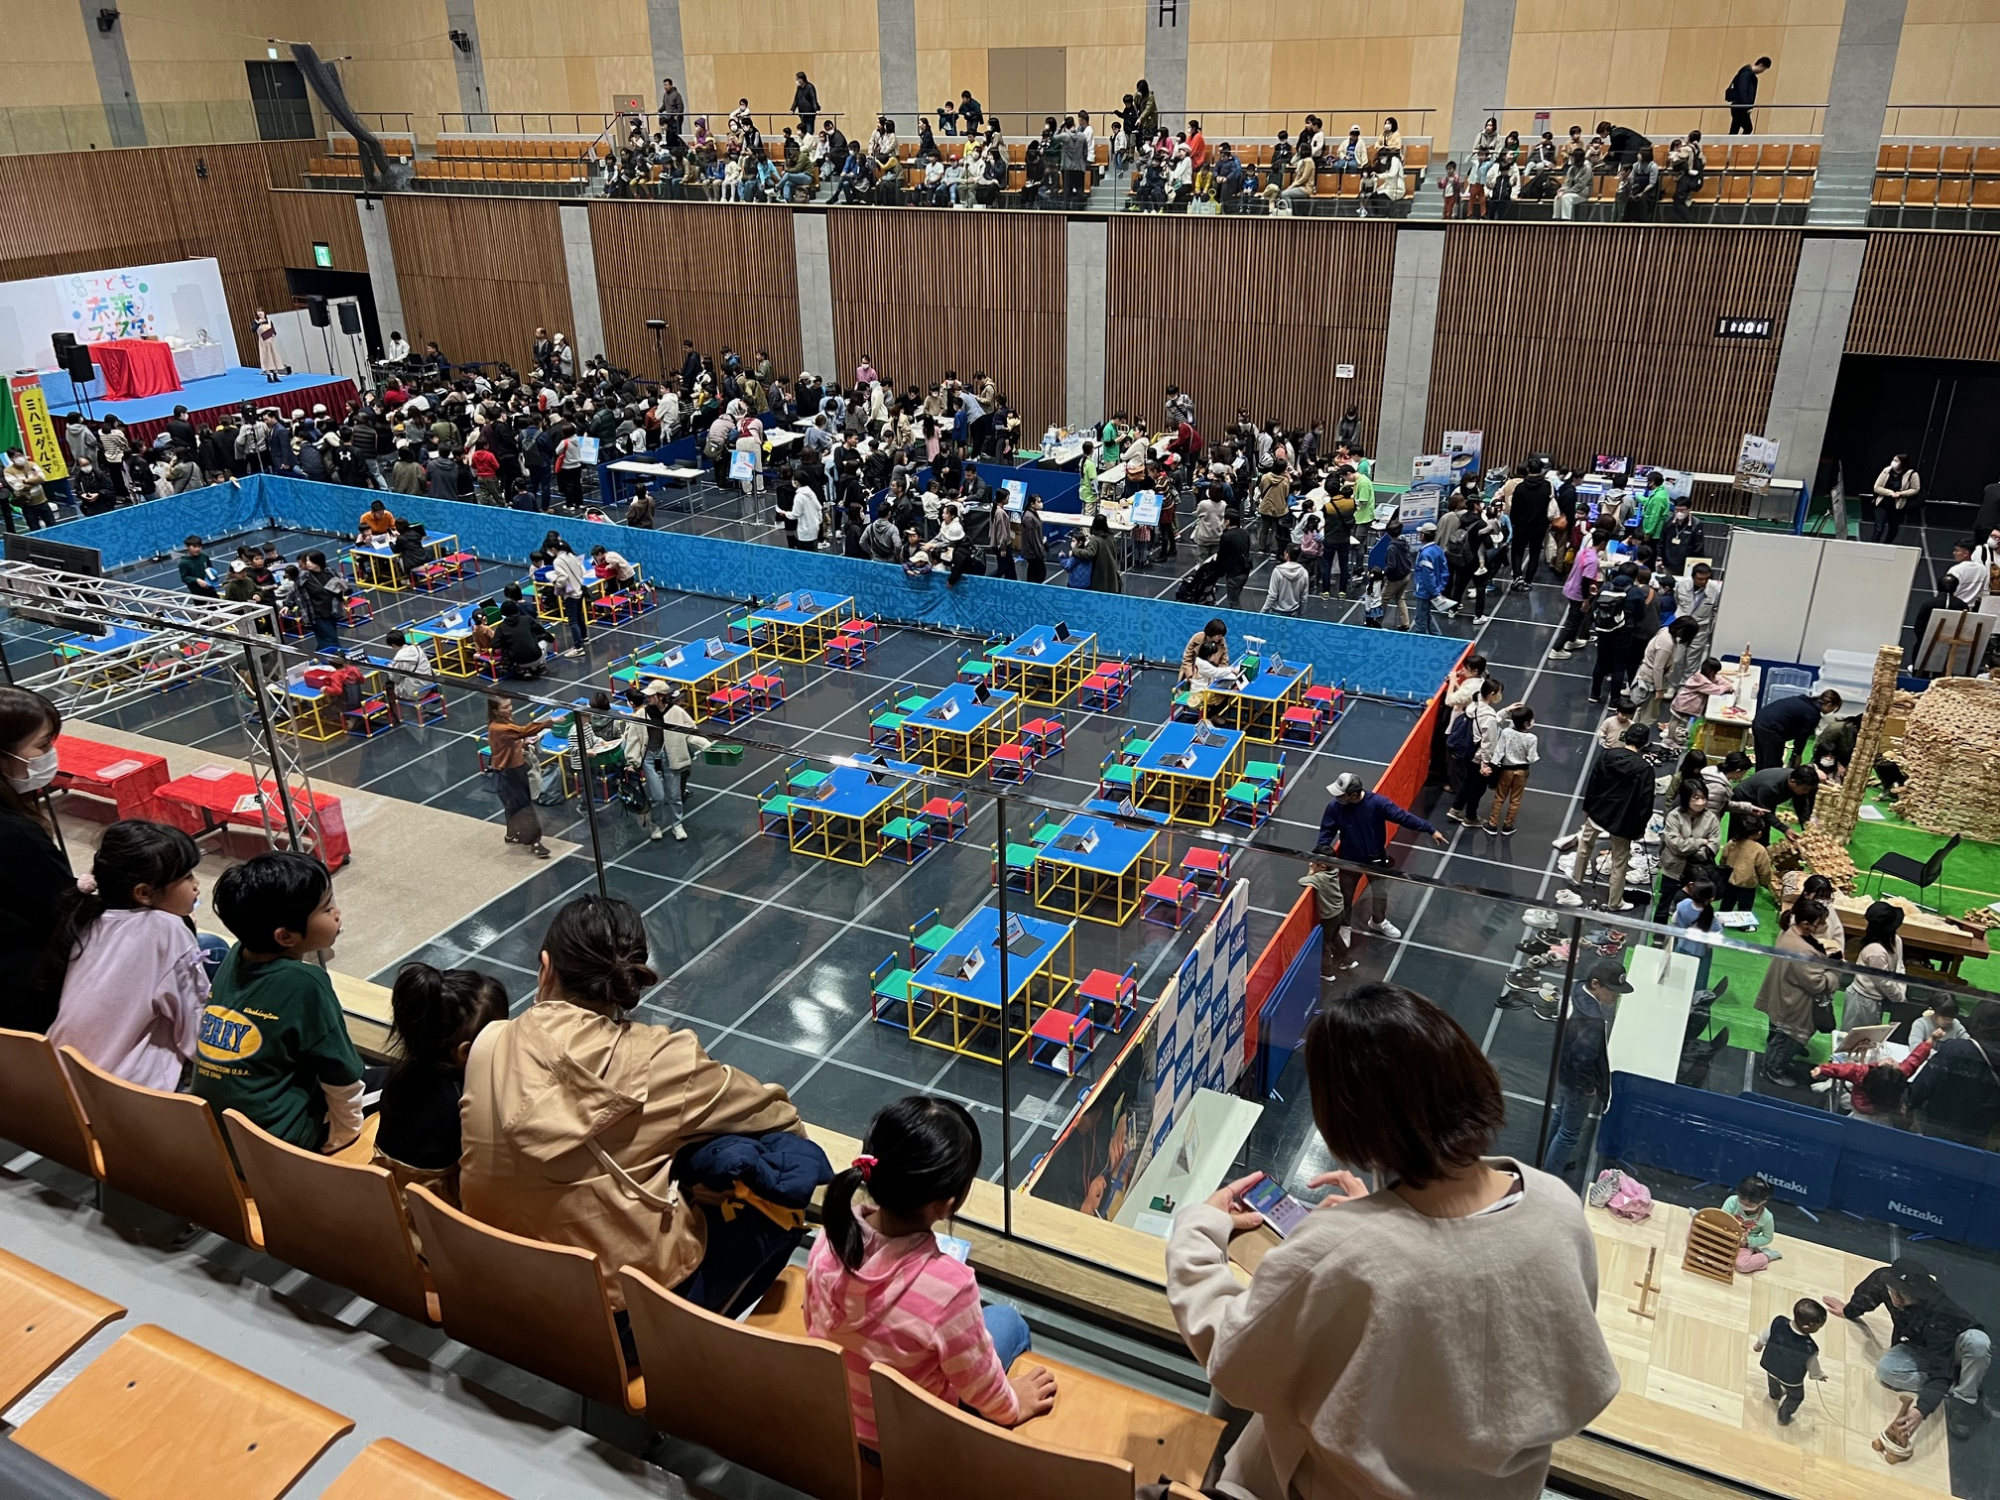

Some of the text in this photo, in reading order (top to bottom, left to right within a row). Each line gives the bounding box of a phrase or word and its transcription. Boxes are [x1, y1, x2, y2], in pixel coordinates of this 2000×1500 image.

[86, 274, 135, 292] こども
[86, 293, 135, 322] 未来
[88, 318, 147, 341] フェスタ
[26, 399, 53, 474] ミハラダルマ
[1887, 1200, 1944, 1226] Nittaku
